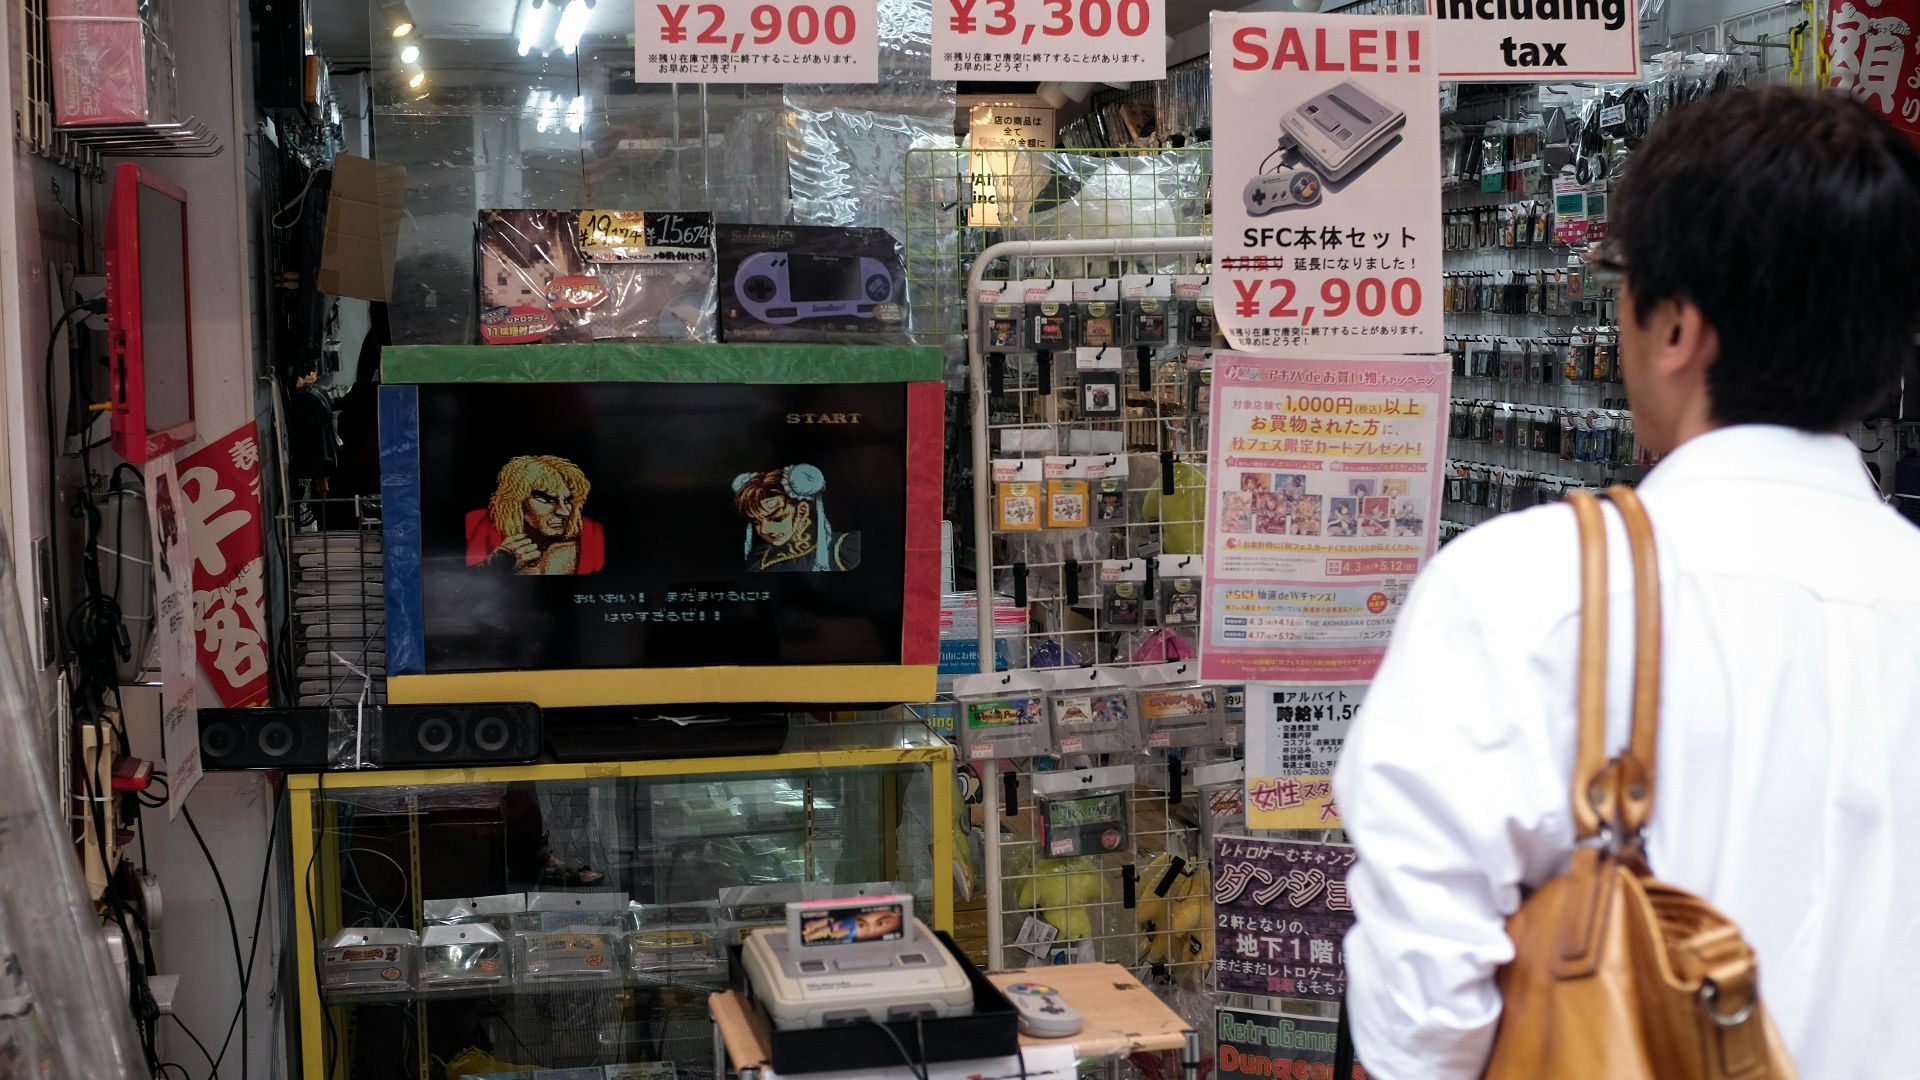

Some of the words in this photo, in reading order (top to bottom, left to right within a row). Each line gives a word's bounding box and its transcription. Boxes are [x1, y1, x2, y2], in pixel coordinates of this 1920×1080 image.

[657, 4, 856, 53] ¥2,900
[950, 0, 1150, 45] ¥3,300
[1437, 0, 1626, 30] including
[1232, 27, 1422, 73] SALE!!
[1500, 36, 1568, 67] tax
[646, 214, 711, 245] ¥15,674
[1243, 225, 1416, 250] SFC本体セット
[1233, 277, 1422, 326] ¥2,900
[786, 413, 861, 424] START
